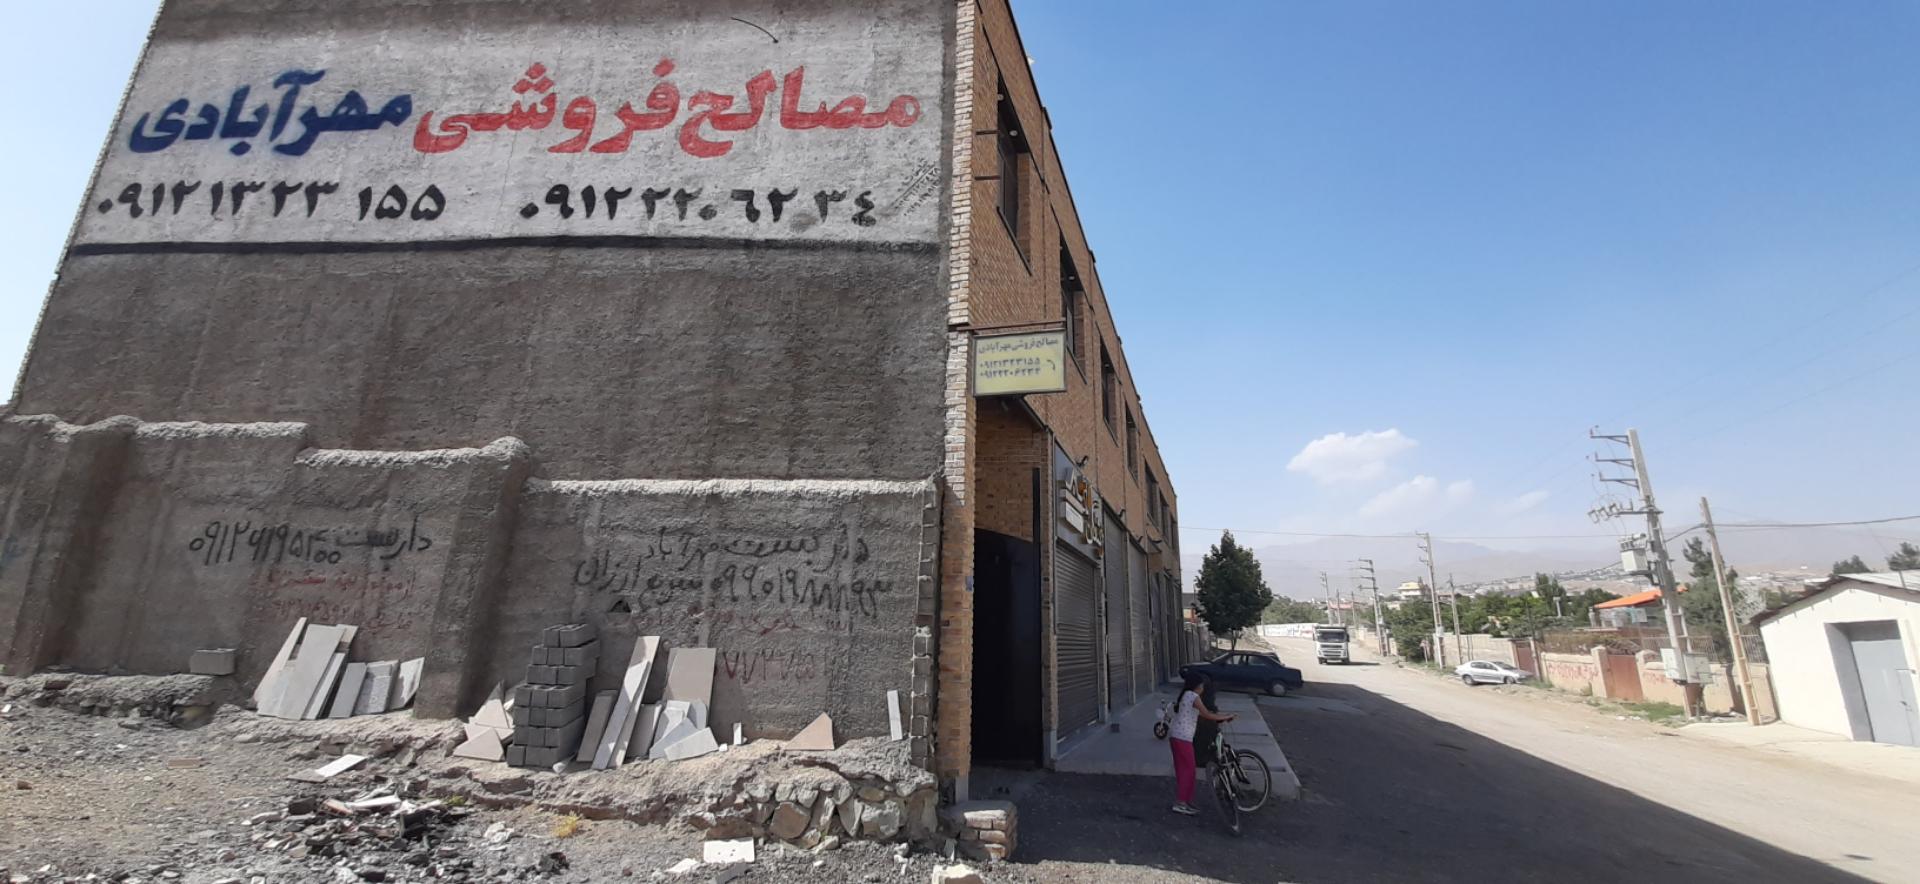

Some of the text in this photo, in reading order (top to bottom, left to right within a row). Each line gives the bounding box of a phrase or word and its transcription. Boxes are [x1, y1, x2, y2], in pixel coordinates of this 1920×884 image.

[128, 57, 921, 158] مصالح فروشی مهرآبادی
